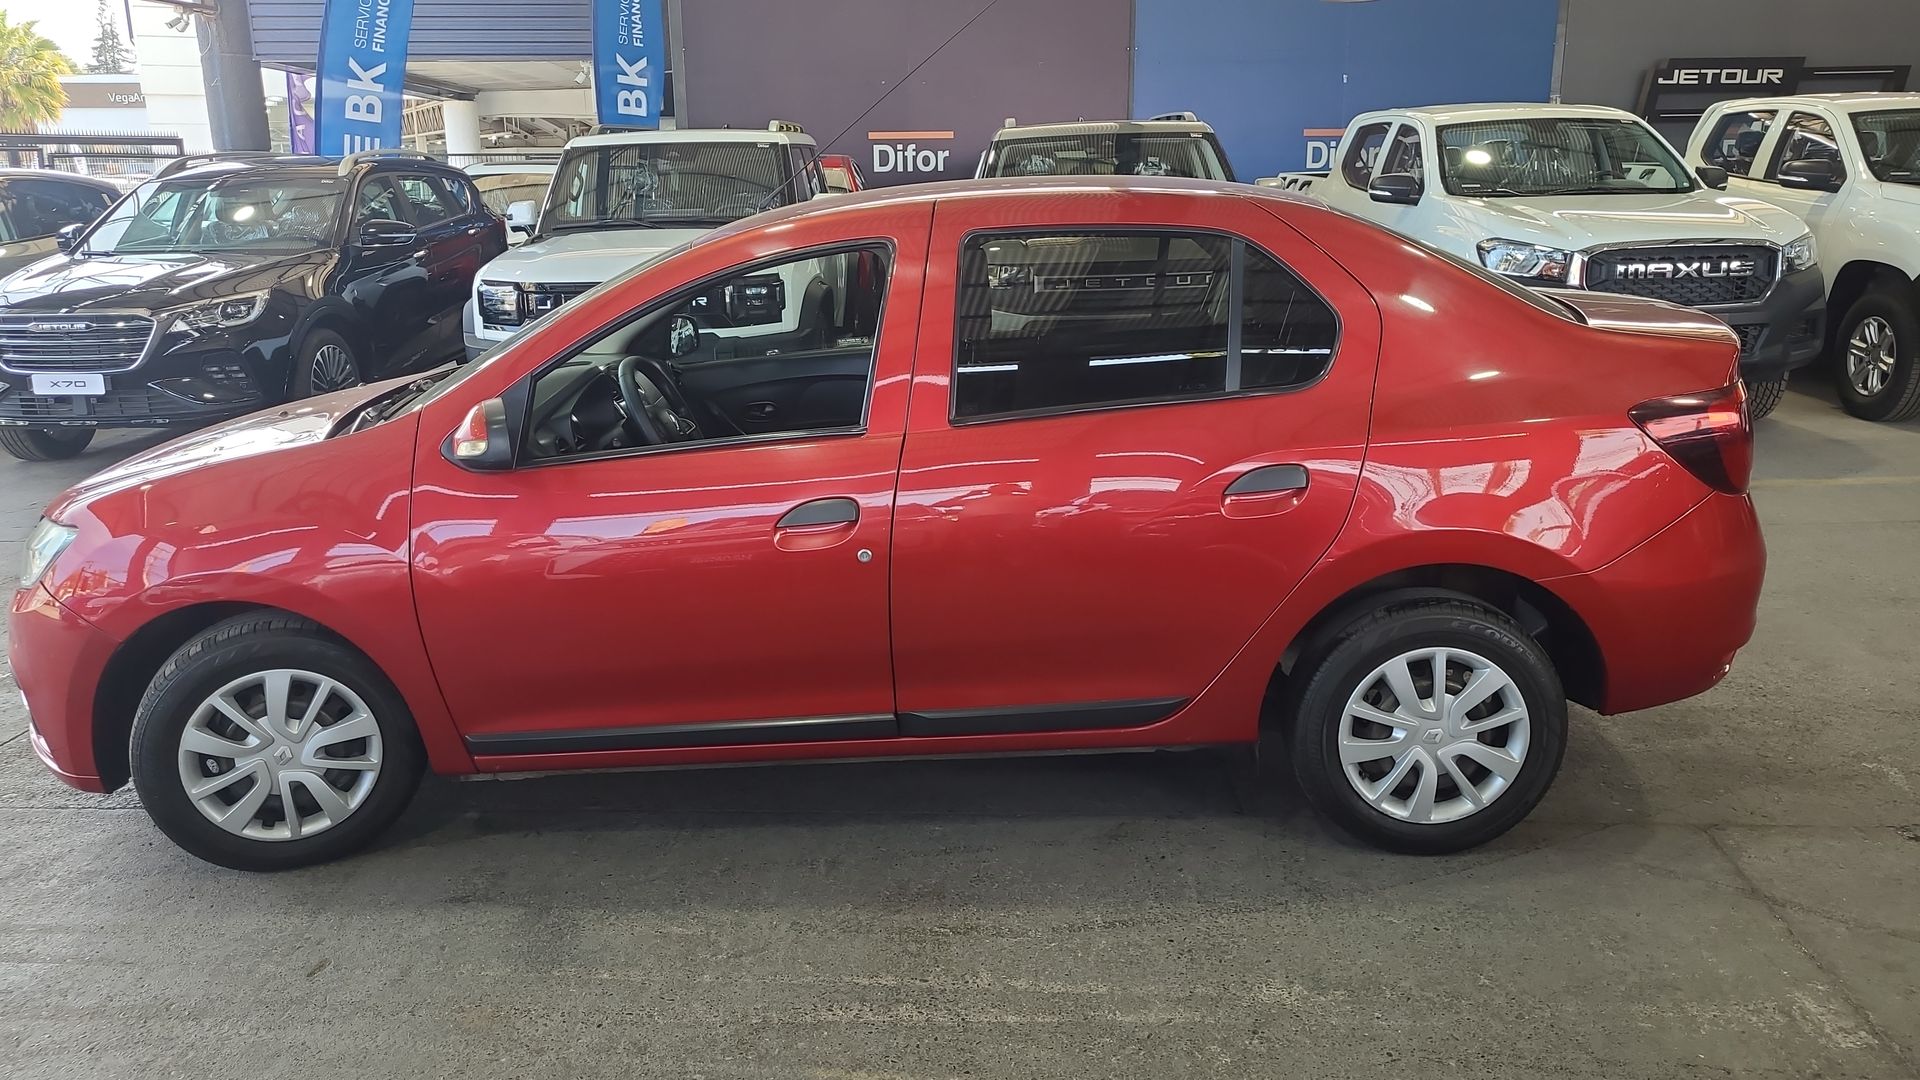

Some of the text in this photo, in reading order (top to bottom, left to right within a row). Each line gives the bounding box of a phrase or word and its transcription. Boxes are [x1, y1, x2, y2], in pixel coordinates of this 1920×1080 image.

[631, 0, 644, 47] FINAN
[345, 56, 387, 123] BK
[616, 52, 648, 117] BK
[1657, 69, 1784, 84] JETOUR
[873, 143, 950, 172] Difor
[1616, 261, 1755, 279] MAXUS
[50, 380, 87, 388] X70
